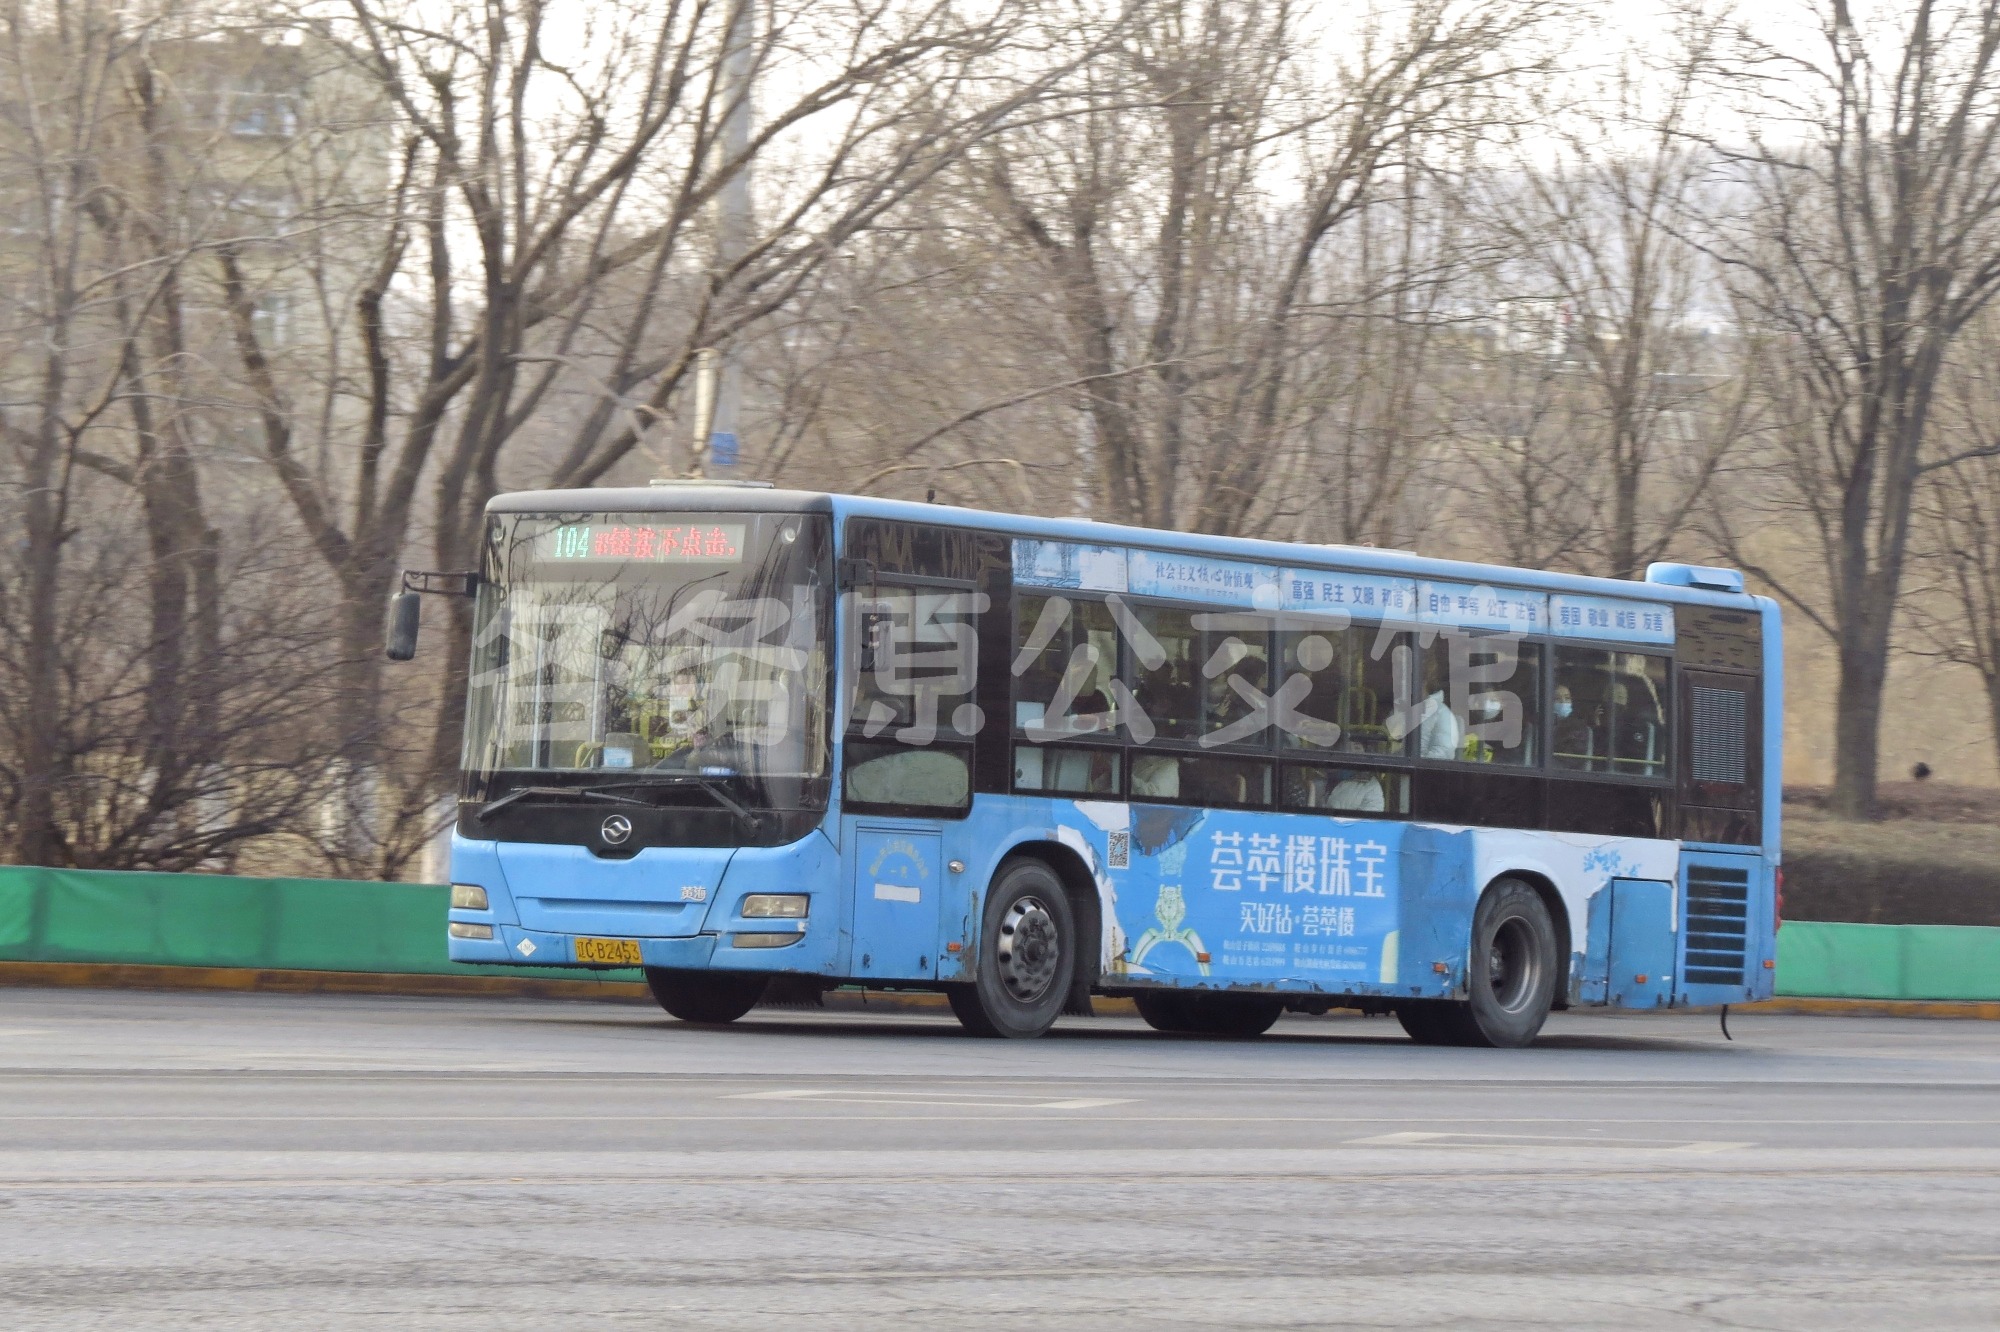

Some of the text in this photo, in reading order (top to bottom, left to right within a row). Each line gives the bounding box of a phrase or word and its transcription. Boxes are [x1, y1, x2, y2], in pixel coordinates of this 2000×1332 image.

[554, 527, 590, 558] 104
[1156, 561, 1254, 589] 社会主义核心价值观
[1292, 580, 1314, 600] 富强
[1322, 583, 1344, 603] 民主
[1352, 586, 1374, 606] 文明
[1429, 593, 1450, 614] 自由
[1458, 596, 1479, 616] 平等
[1487, 599, 1508, 618] 公正
[1561, 606, 1662, 632] 爱国 敬业 诚信 友善
[1210, 830, 1387, 898] 荟萃楼珠宝
[681, 886, 706, 902] 黄海
